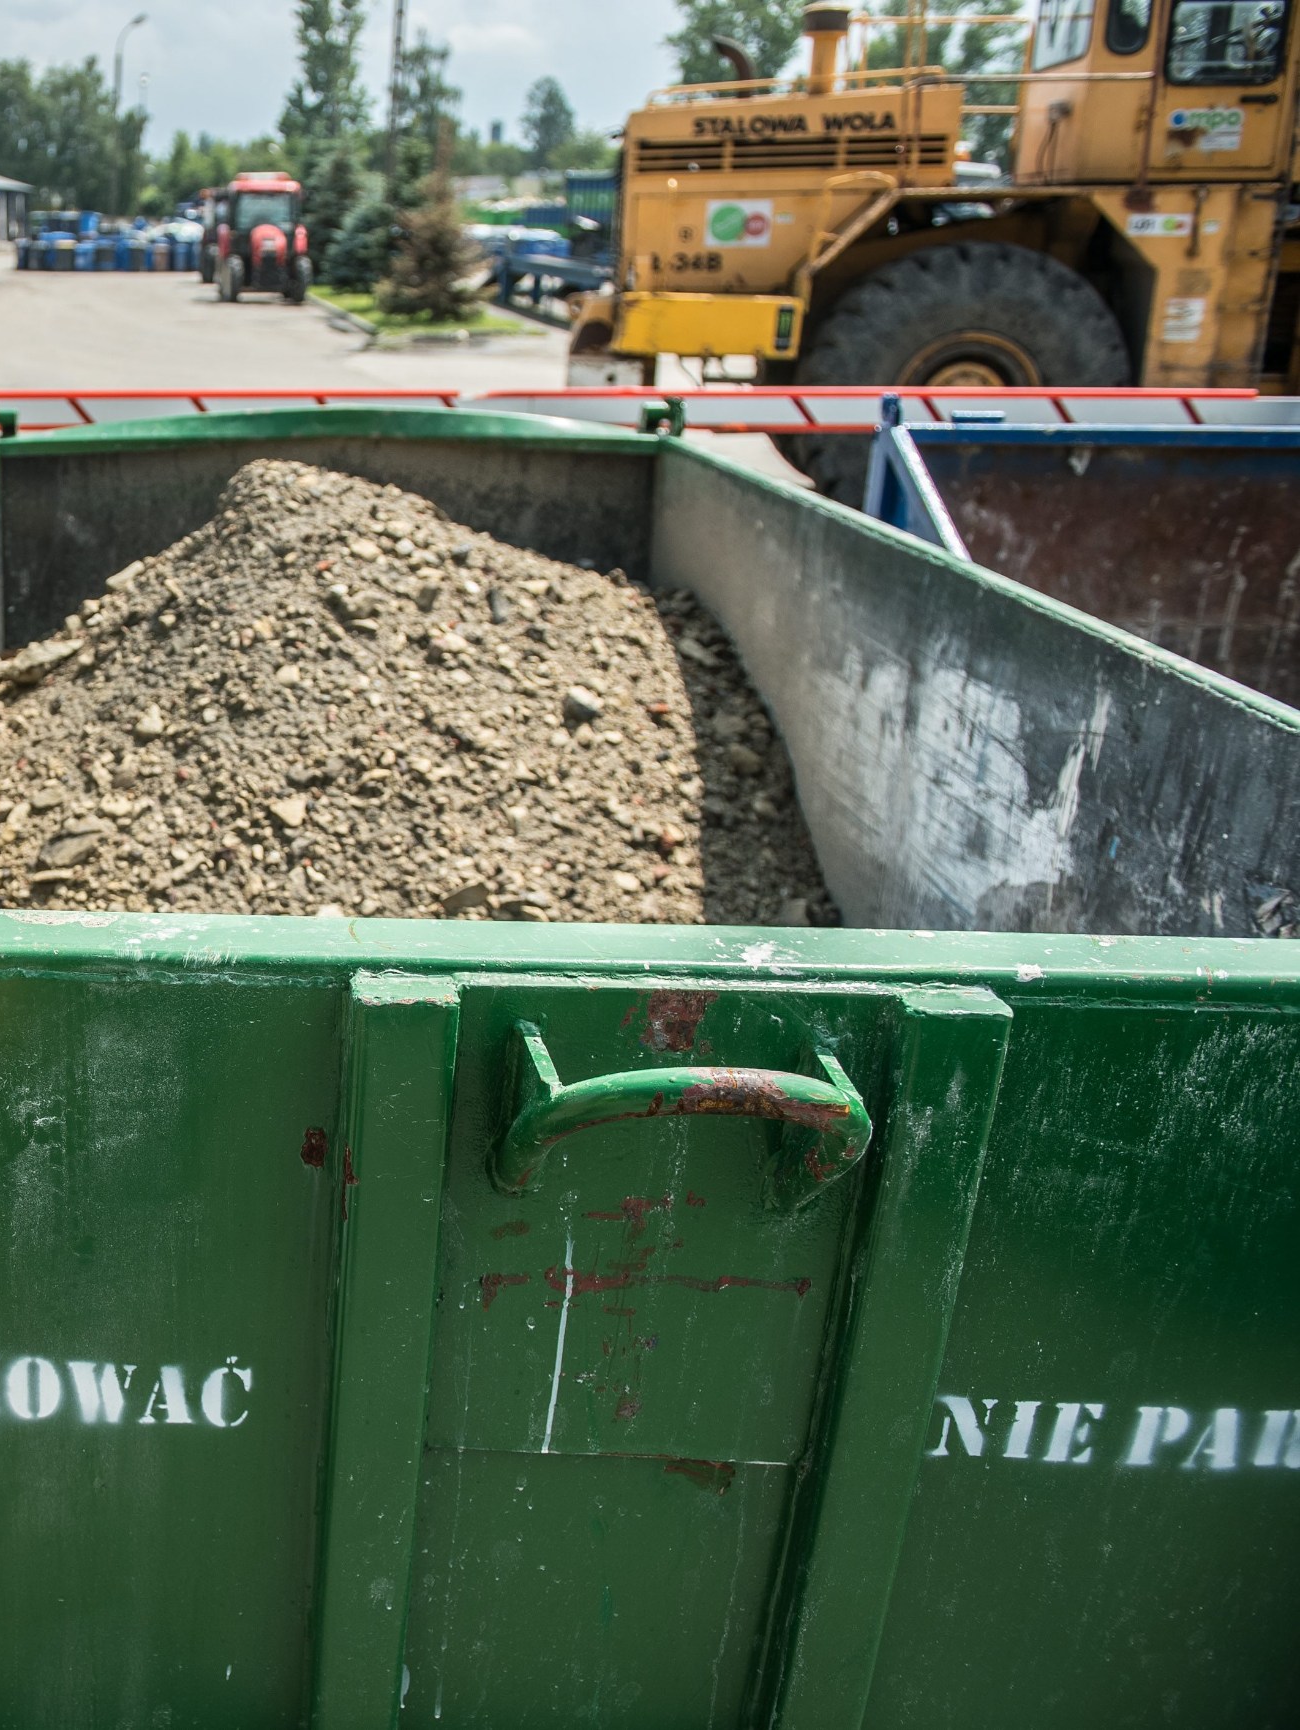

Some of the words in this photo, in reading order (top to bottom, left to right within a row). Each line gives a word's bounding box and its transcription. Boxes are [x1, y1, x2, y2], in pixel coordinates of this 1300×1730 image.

[693, 114, 809, 135] STALOWA
[821, 112, 895, 130] WOLA
[926, 1395, 1104, 1464] NIE
